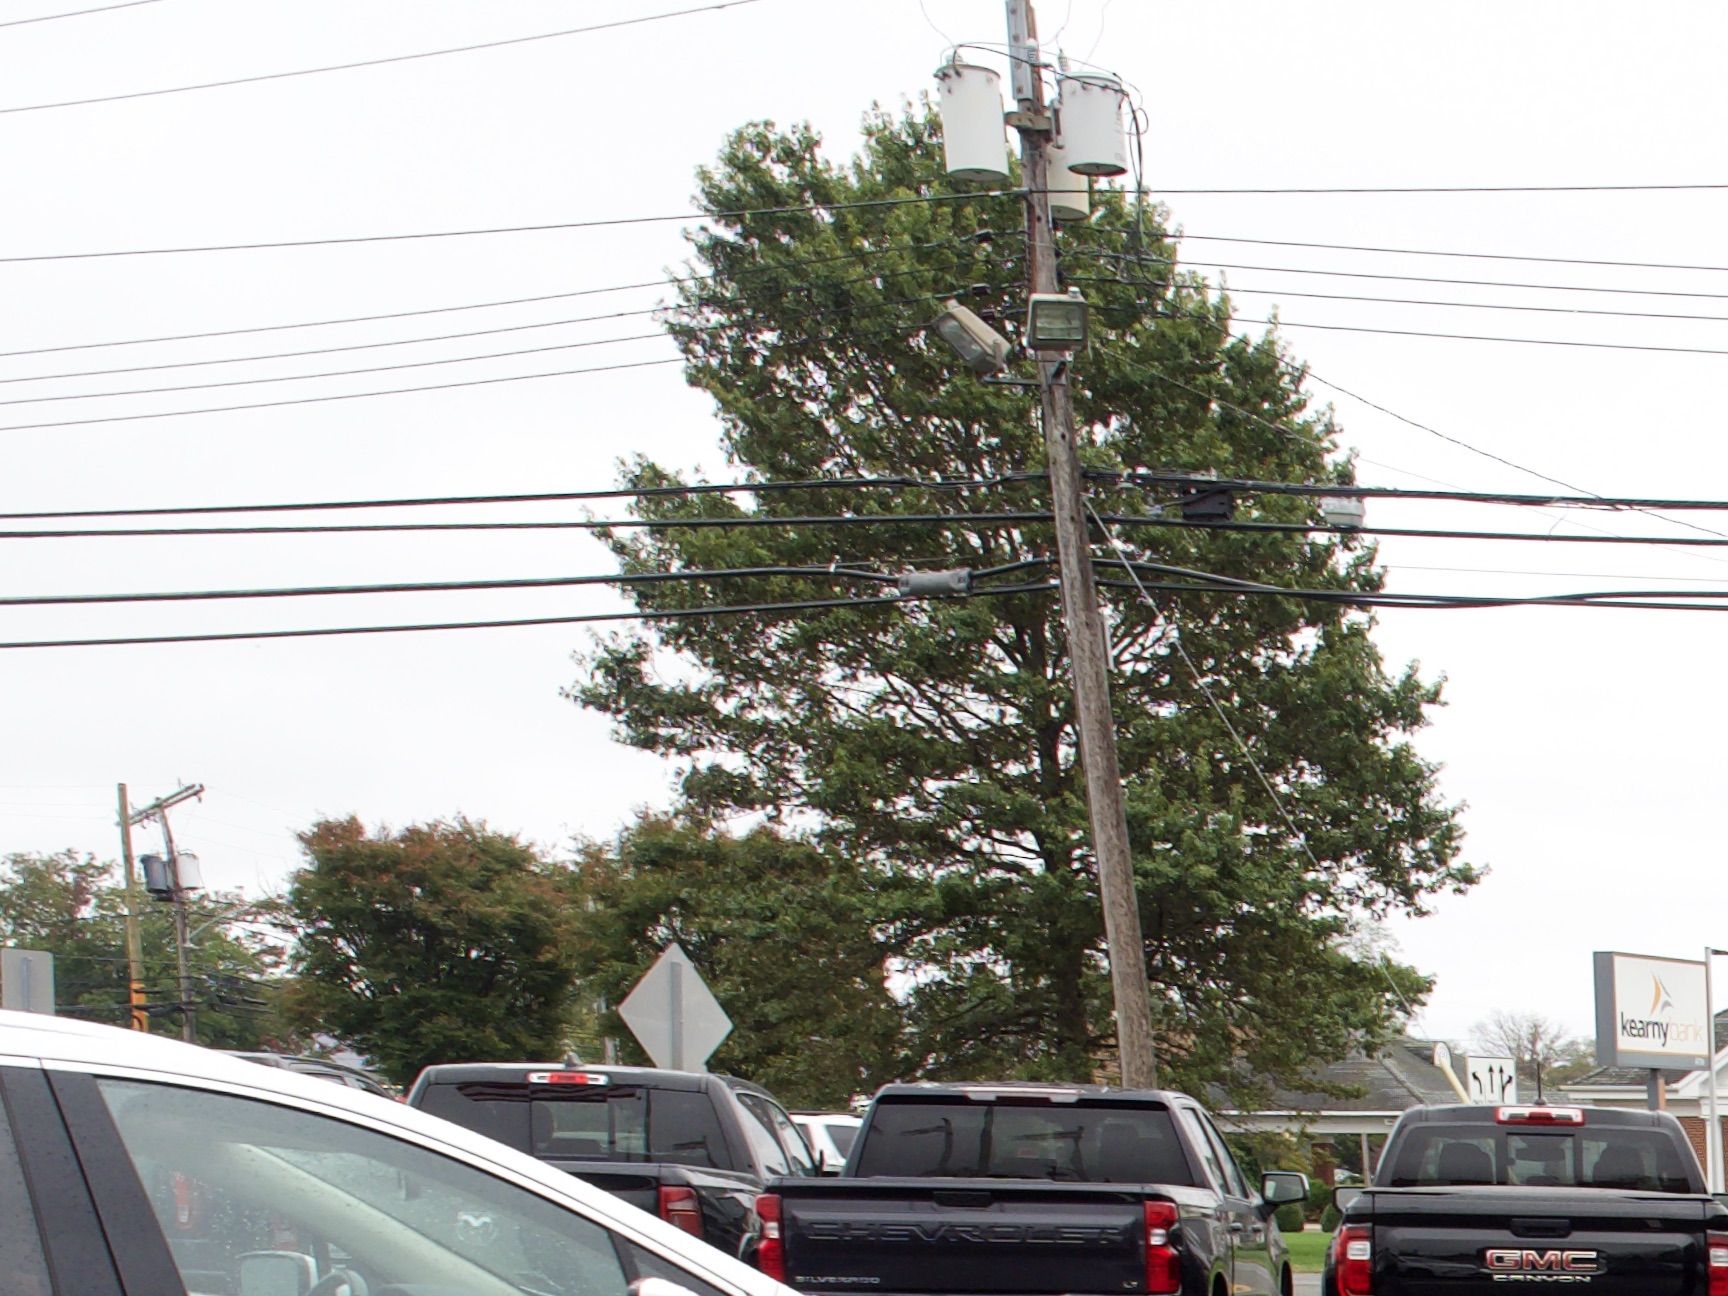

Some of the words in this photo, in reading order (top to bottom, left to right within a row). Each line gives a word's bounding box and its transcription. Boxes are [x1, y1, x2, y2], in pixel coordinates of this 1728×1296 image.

[807, 1221, 1127, 1244] CHEVROLET
[1486, 1249, 1598, 1272] GMC
[795, 1275, 881, 1284] SILVERADO
[1492, 1274, 1592, 1283] CANYON
